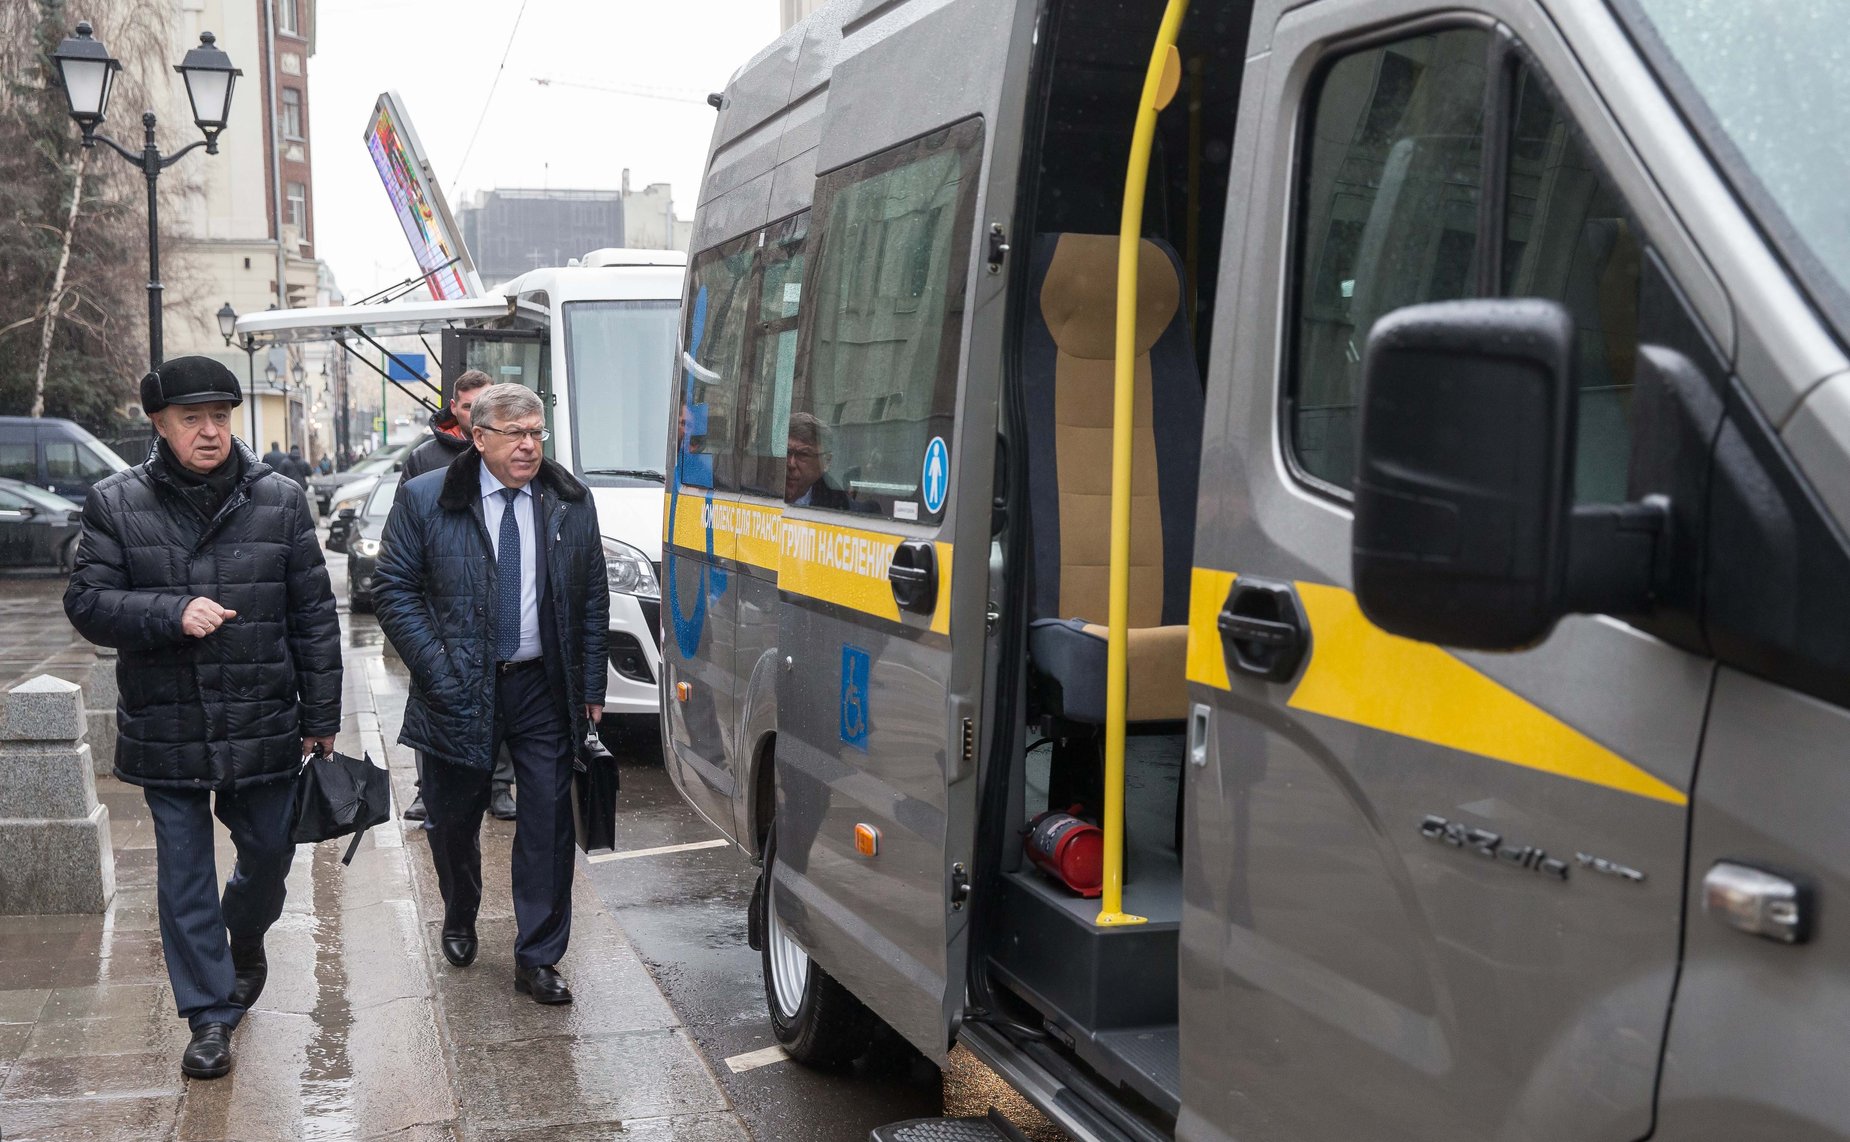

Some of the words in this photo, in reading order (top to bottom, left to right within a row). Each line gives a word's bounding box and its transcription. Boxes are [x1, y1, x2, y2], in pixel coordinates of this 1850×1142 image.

[701, 503, 734, 533] КОМПЛЕКС
[734, 507, 751, 538] ДЛЯ
[781, 523, 816, 562] ГРУПП
[818, 530, 894, 581] НАСЕЛЕНИЯ
